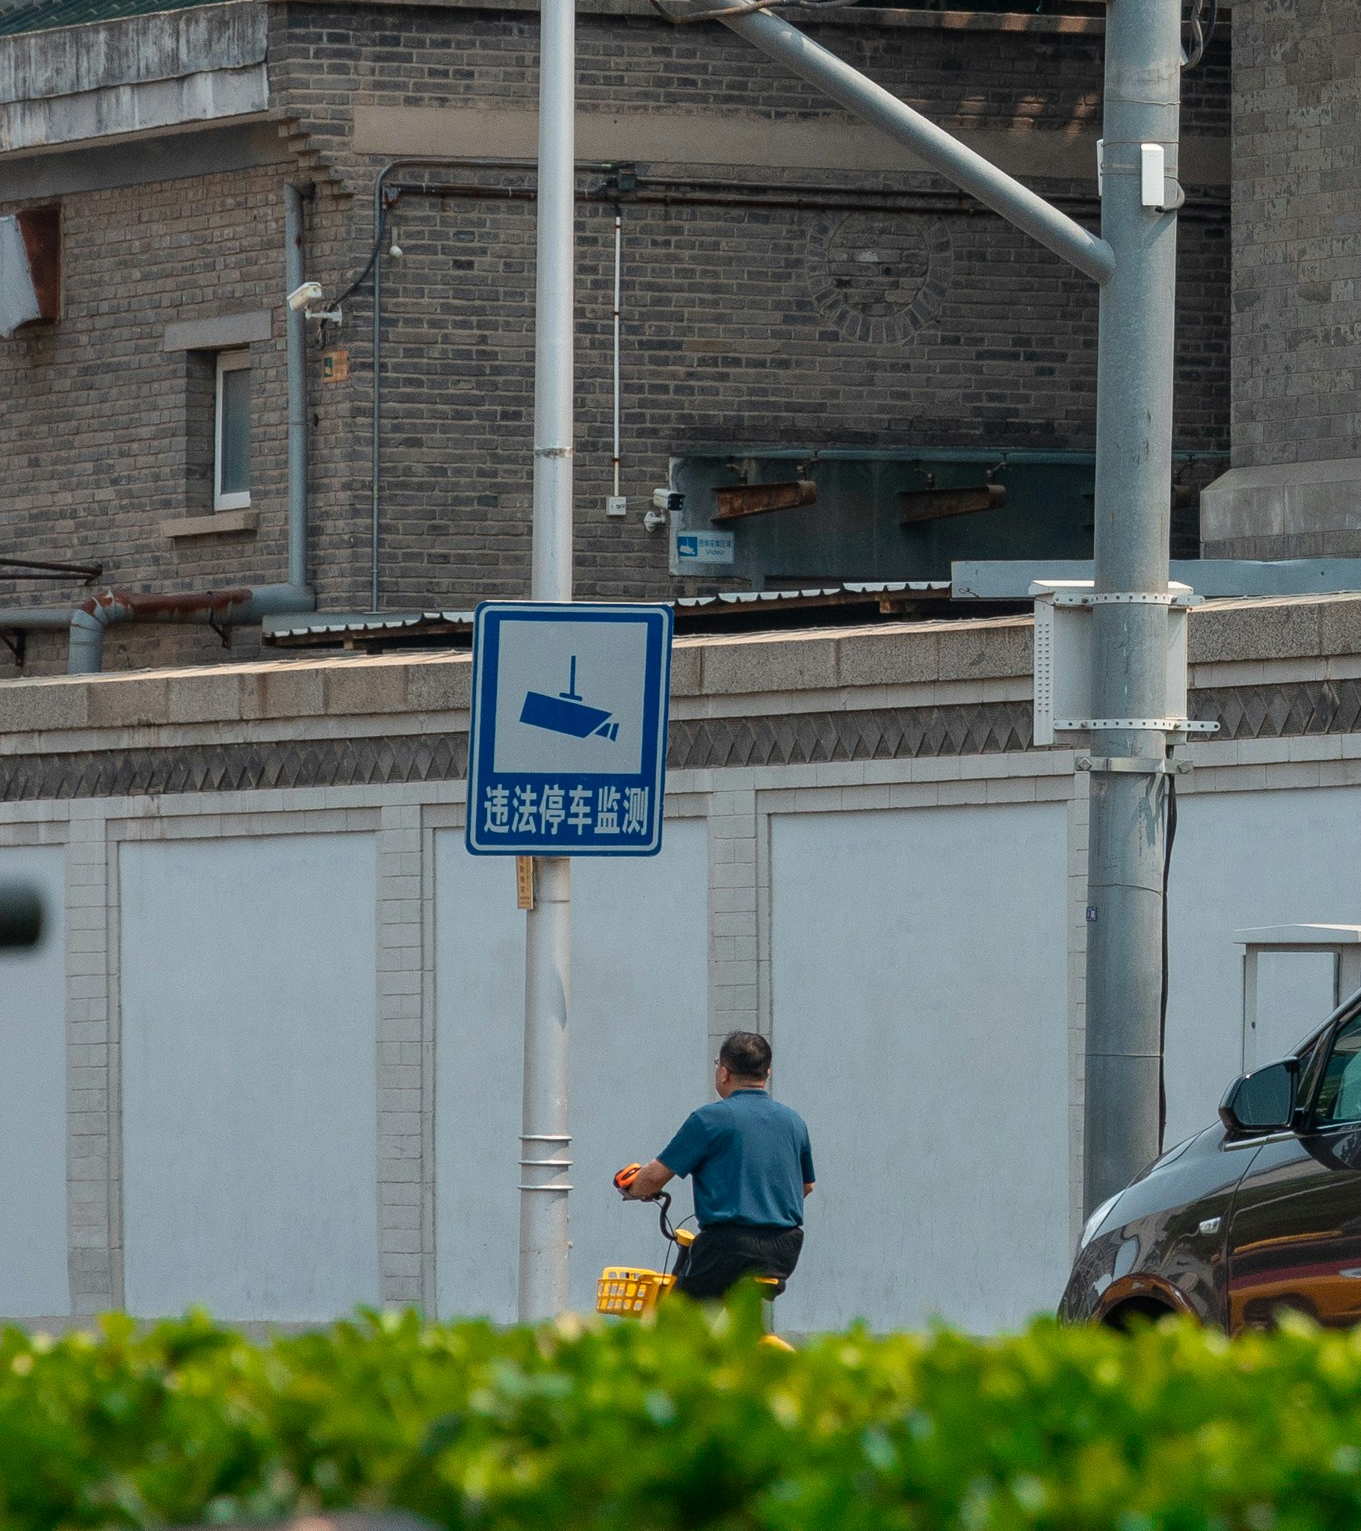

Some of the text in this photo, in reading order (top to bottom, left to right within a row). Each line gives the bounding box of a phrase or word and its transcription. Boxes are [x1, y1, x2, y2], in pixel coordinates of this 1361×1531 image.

[483, 783, 650, 836] 违法停车监测
